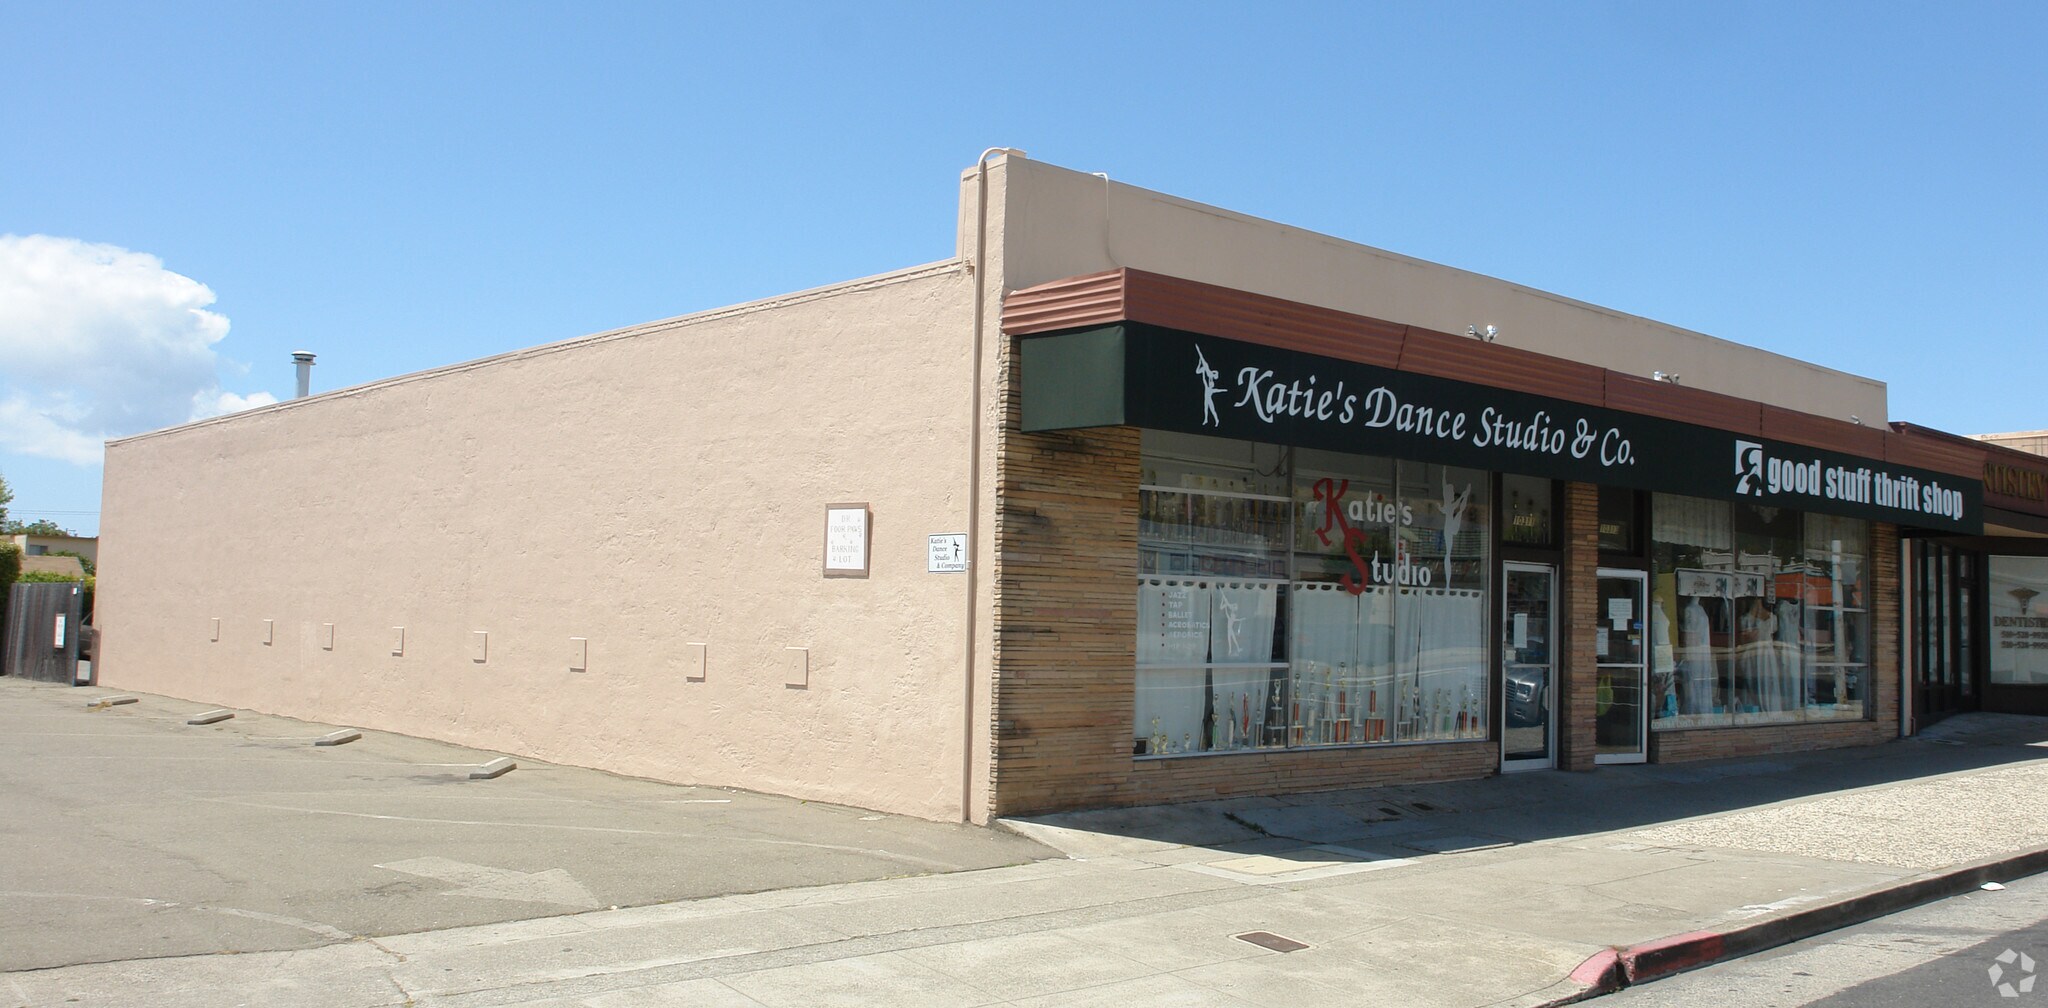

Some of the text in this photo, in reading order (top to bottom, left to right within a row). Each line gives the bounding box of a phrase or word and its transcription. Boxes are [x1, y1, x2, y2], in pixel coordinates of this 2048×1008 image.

[1233, 366, 1635, 467] Katie's Dance Studio & Co.
[1312, 477, 1413, 546] Katie's
[1767, 456, 1964, 521] good stuff thrift shop
[1339, 527, 1431, 596] Studio
